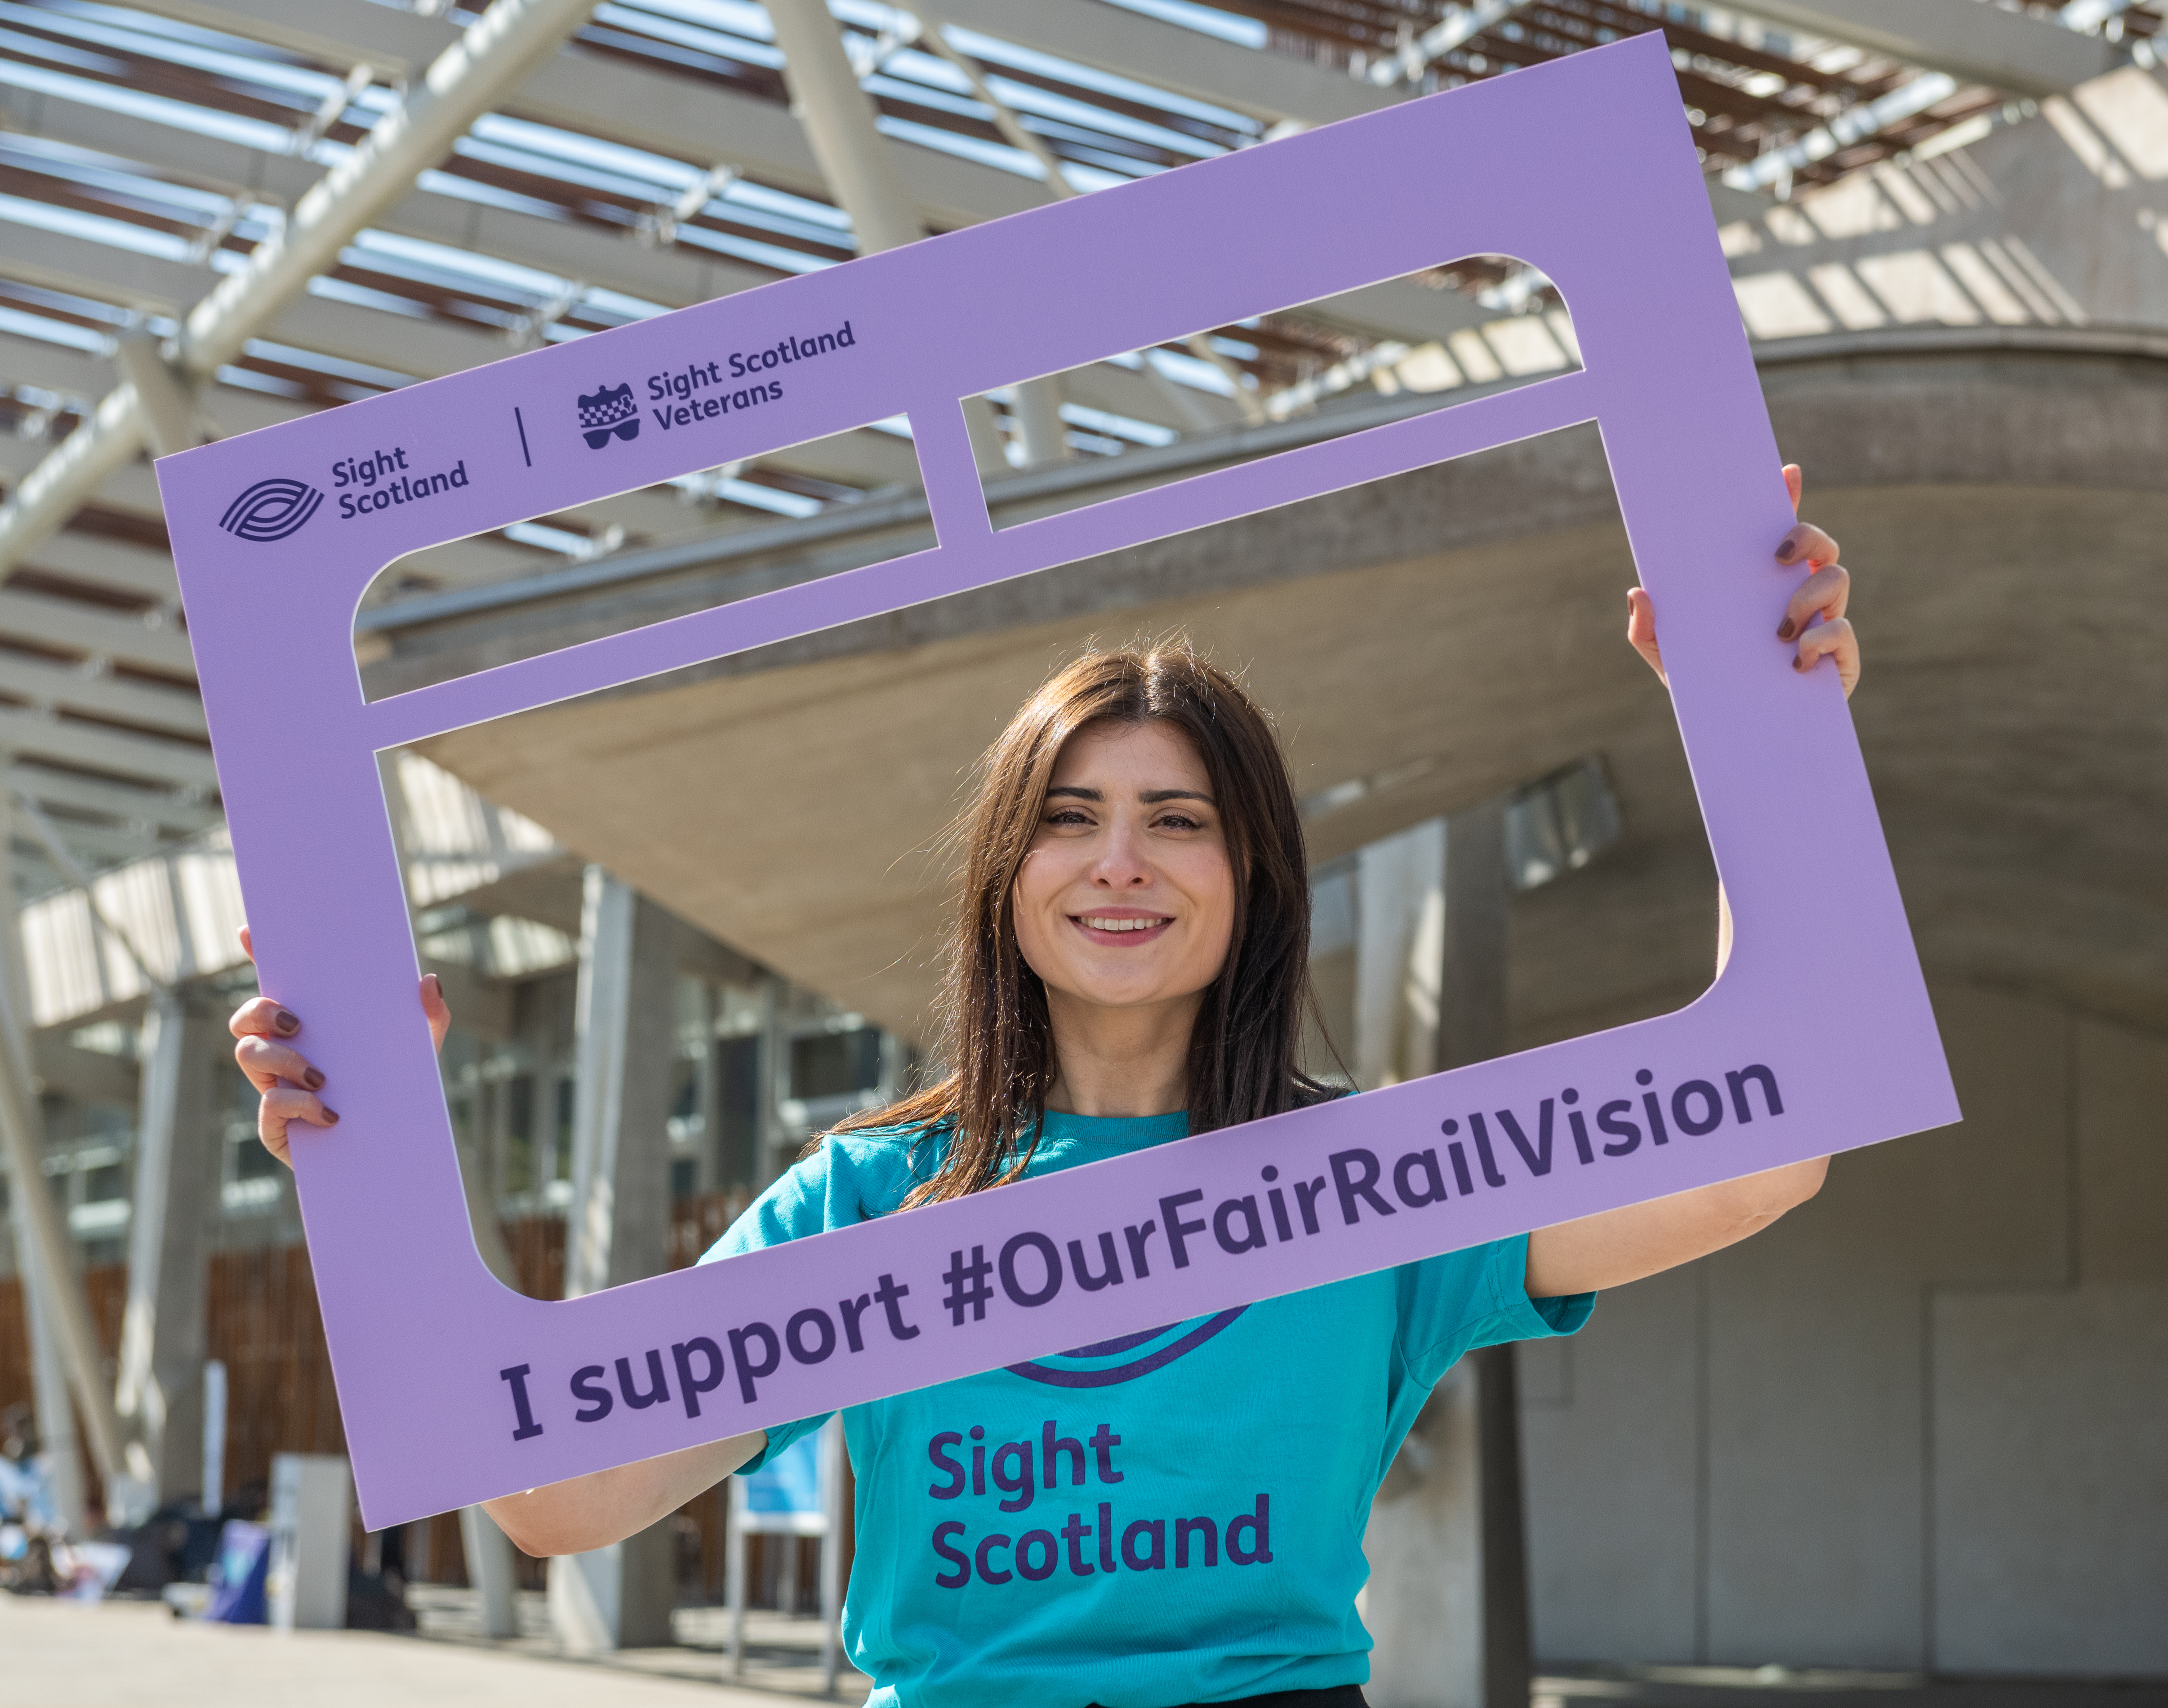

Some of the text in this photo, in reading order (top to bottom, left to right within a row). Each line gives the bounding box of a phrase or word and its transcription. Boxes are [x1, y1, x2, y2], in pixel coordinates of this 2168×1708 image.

[647, 320, 856, 401] Sight Scotland
[652, 381, 783, 431] Veterans
[332, 447, 410, 488] Sight
[338, 460, 469, 520] Scotland
[499, 1063, 1785, 1442] I support #OurFairRailVision
[928, 1419, 1125, 1513] Sight
[931, 1492, 1273, 1590] Scotland
